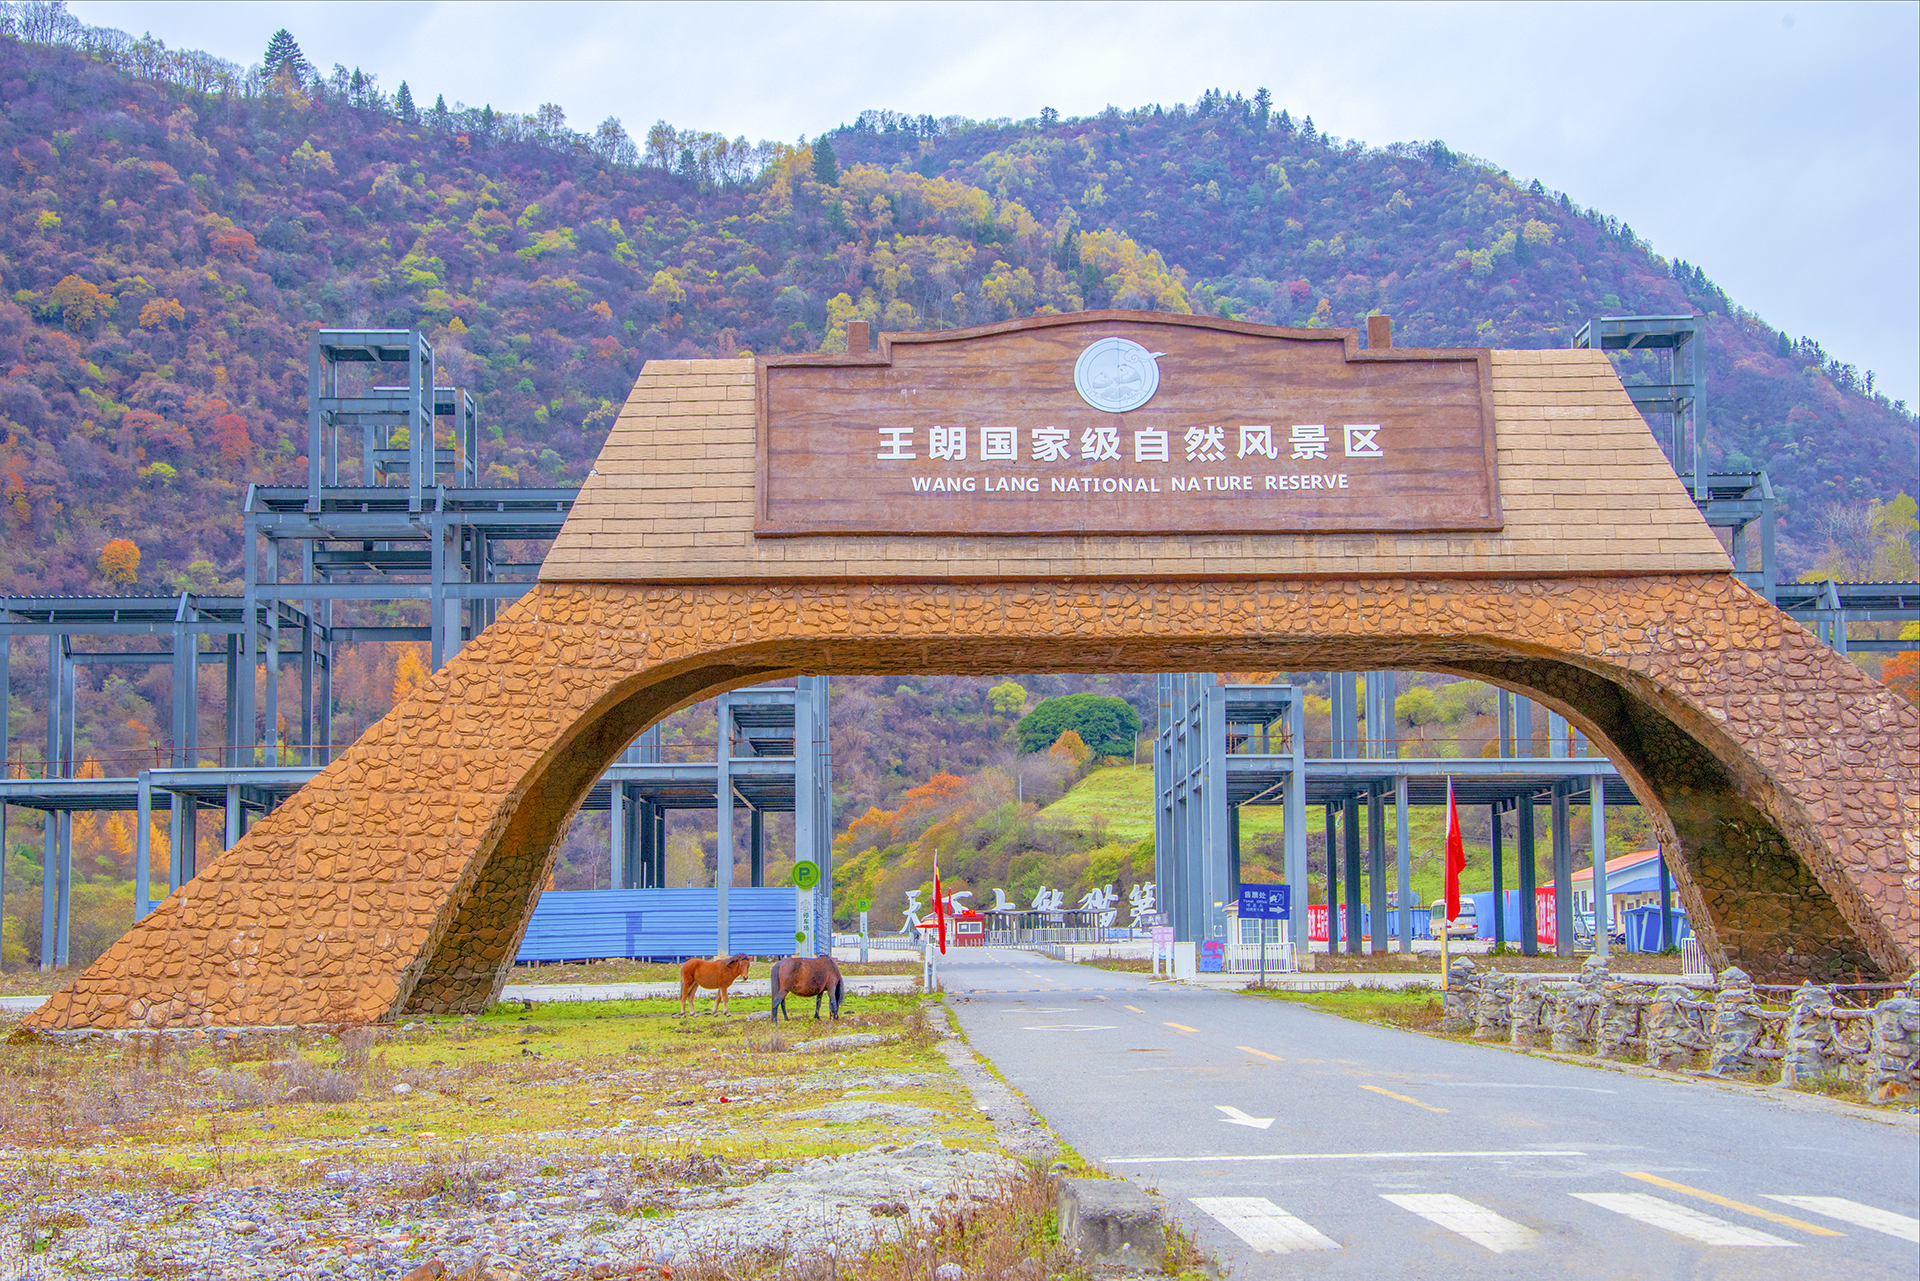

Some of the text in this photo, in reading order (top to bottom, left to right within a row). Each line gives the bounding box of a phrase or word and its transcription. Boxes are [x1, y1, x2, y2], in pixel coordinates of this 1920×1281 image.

[876, 424, 1384, 462] 王朗国家级自然风景区
[912, 475, 1348, 491] WANG LANG NATIONAL NATURE RESERVE
[798, 867, 811, 882] P
[1244, 891, 1266, 899] 售票处
[802, 912, 810, 932] 停车场
